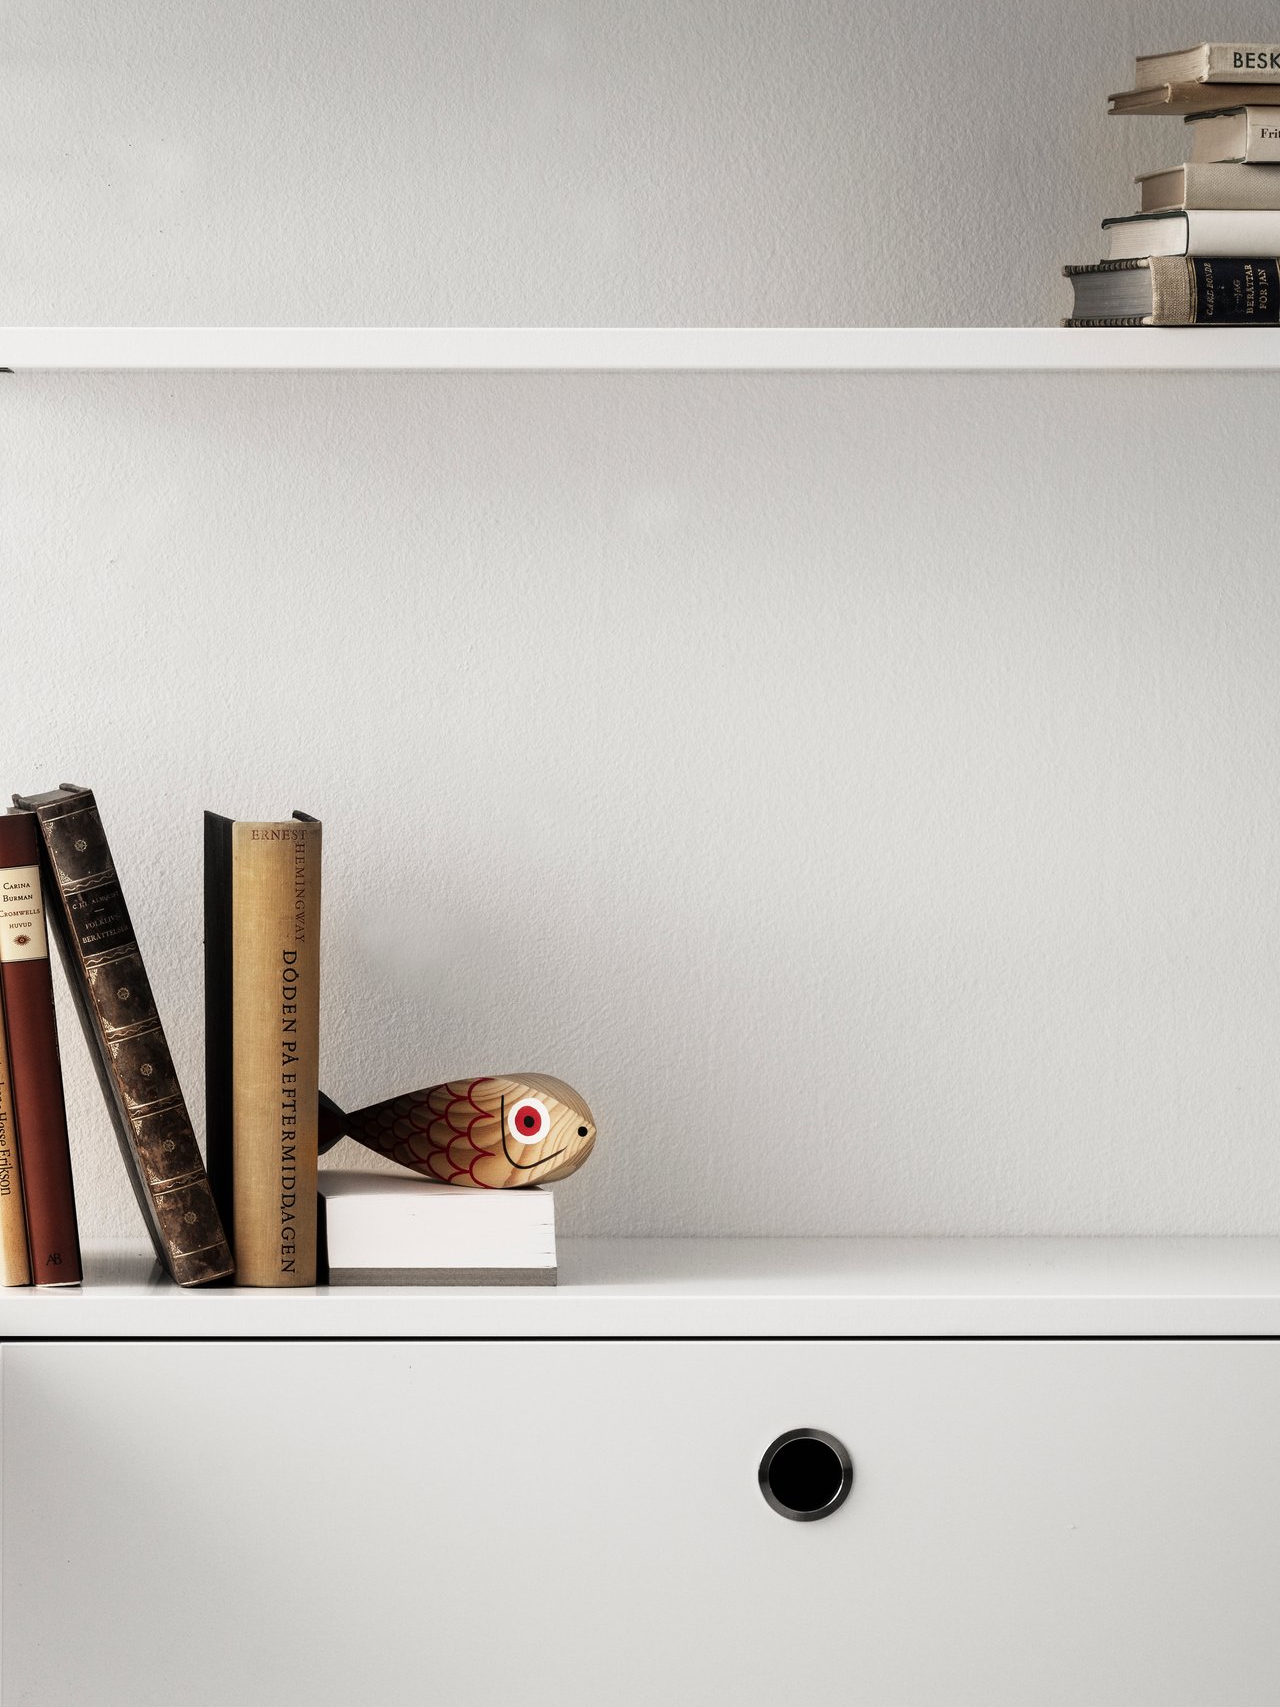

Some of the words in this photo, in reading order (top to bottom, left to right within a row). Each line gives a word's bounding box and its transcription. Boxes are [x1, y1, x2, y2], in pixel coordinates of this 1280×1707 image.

[251, 829, 307, 841] ERNEST
[294, 842, 306, 943] HEMINGWAY
[281, 949, 300, 1033] DÖDEN
[281, 1040, 299, 1067] PÅ
[279, 1072, 297, 1273] EFTERMIDDAGEN
